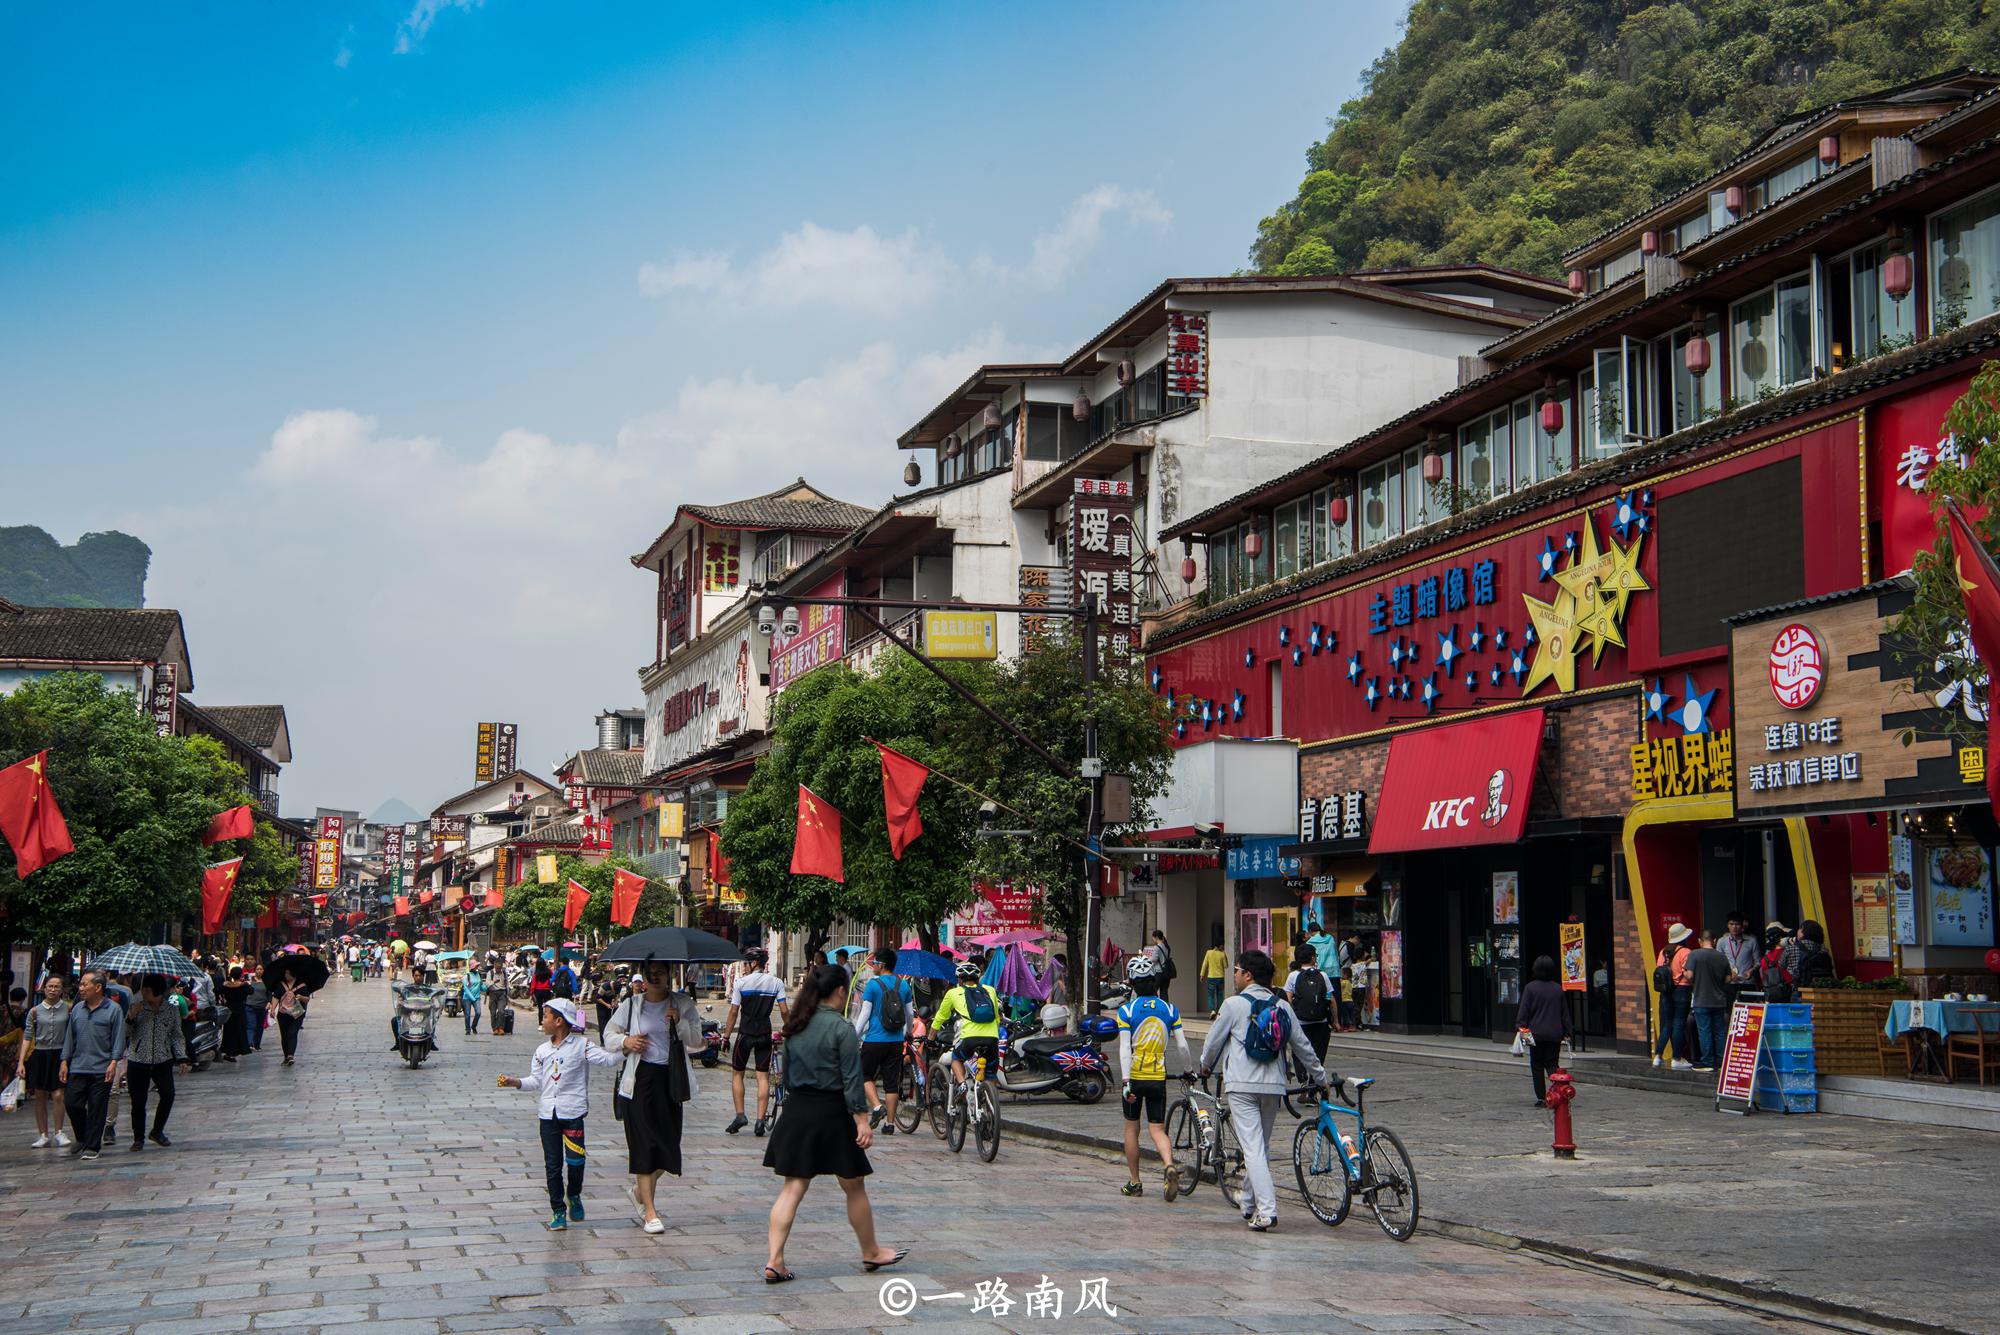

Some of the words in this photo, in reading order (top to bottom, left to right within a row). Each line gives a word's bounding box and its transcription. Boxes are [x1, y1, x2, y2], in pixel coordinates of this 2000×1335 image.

[1175, 334, 1200, 394] 黑山羊
[1082, 480, 1128, 494] 有电梯
[1369, 559, 1497, 635] 主题蜡像馆
[1539, 609, 1569, 628] ANGELINA
[1764, 717, 1838, 750] 连续13年
[1749, 753, 1859, 790] 荣获诚信单位
[1960, 747, 1985, 784] 粤
[1300, 791, 1362, 843] 肯德基
[1421, 796, 1476, 831] KFC
